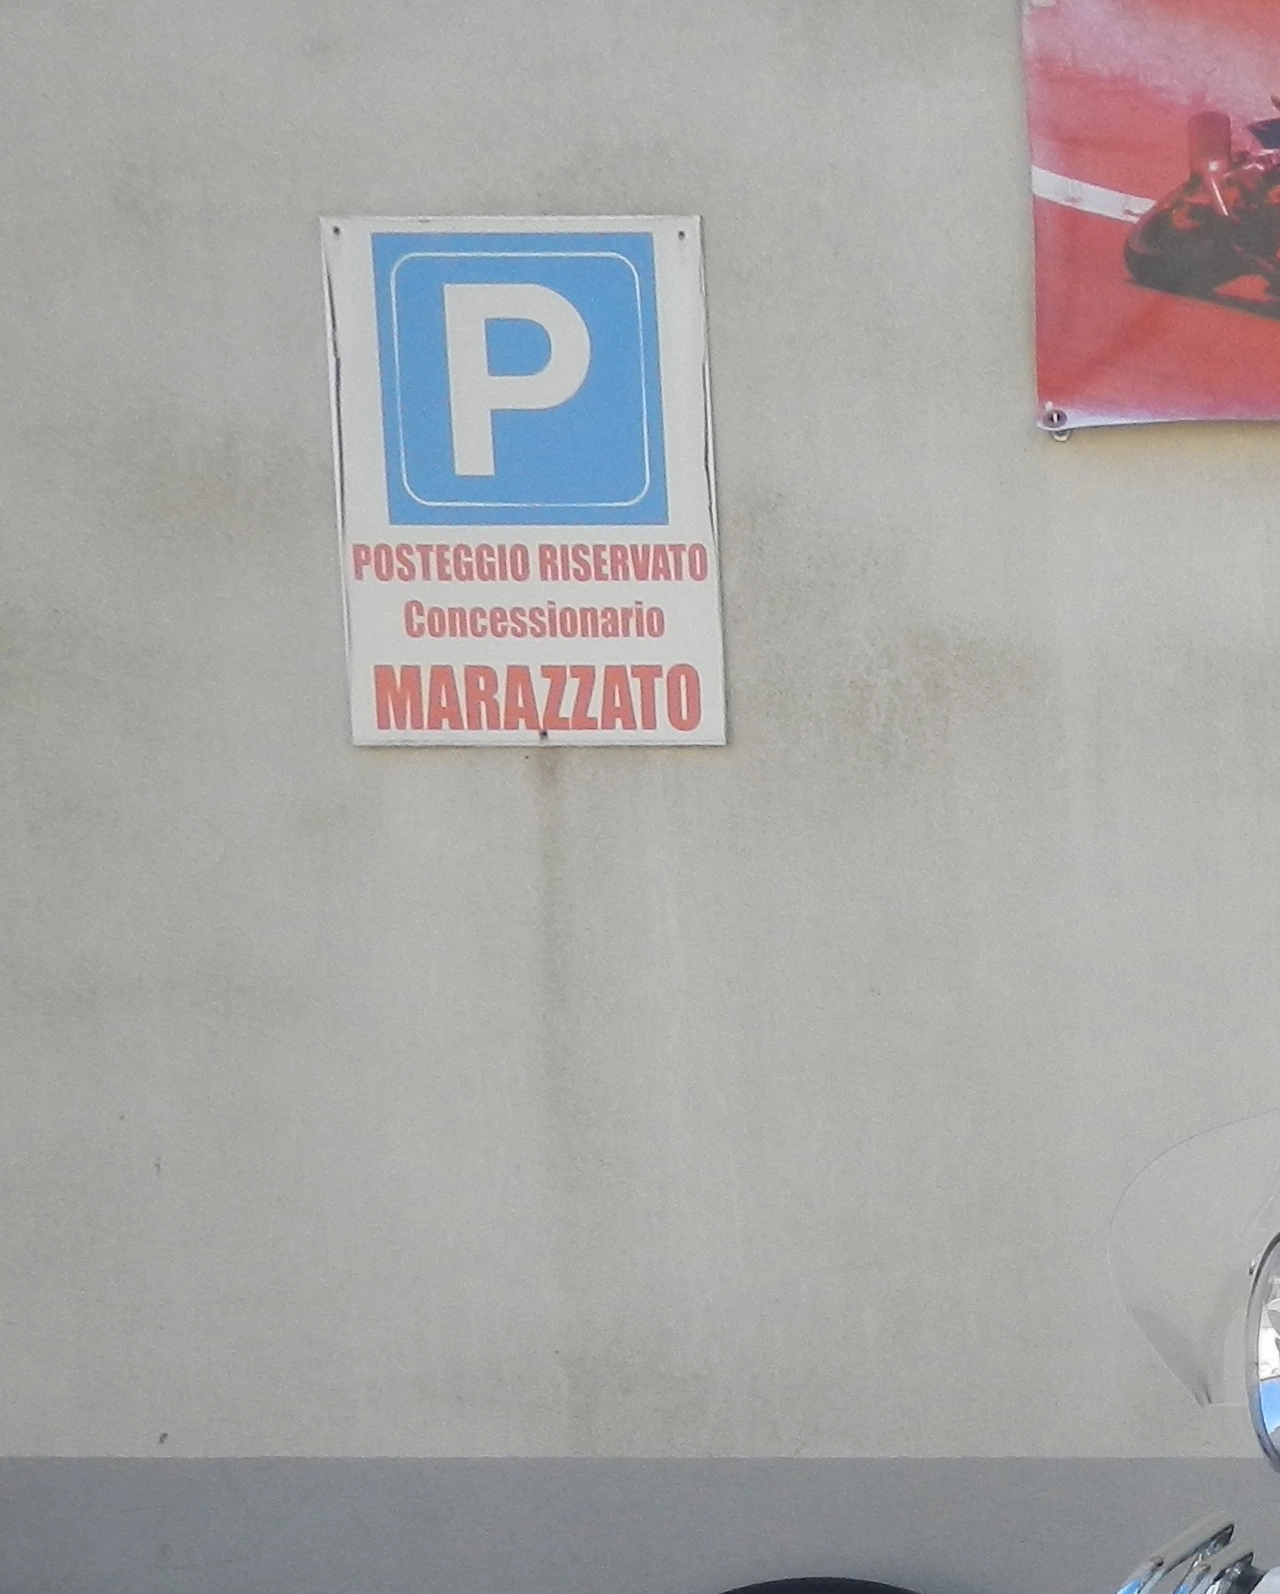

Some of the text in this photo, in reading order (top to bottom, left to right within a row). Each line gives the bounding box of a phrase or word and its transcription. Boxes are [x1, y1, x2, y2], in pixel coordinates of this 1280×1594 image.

[444, 283, 591, 477] P
[352, 543, 708, 583] POSTEGGIO RISERVATO
[403, 599, 666, 639] Concessionario
[373, 664, 702, 732] MARAZZATO
